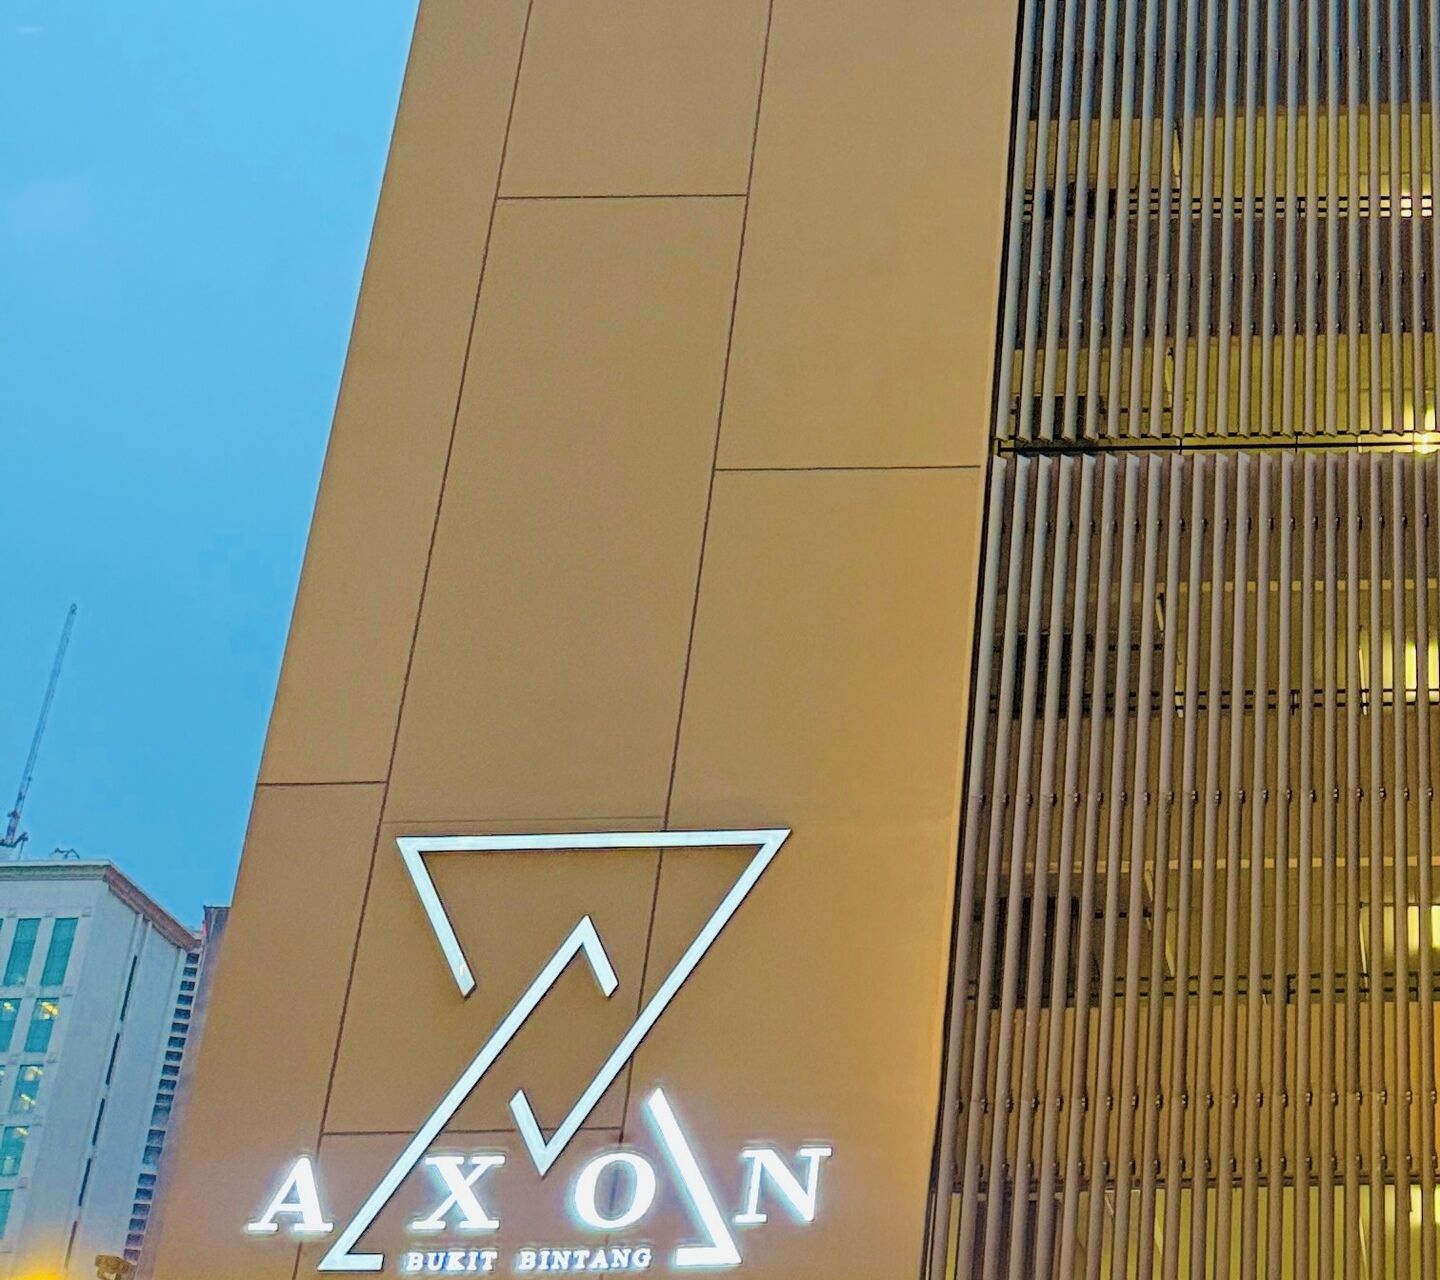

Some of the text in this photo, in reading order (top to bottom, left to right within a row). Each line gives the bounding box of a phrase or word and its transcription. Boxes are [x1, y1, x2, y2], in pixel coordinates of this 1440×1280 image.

[246, 1145, 832, 1234] AXON
[405, 1246, 653, 1274] BUKIT BINTANG
